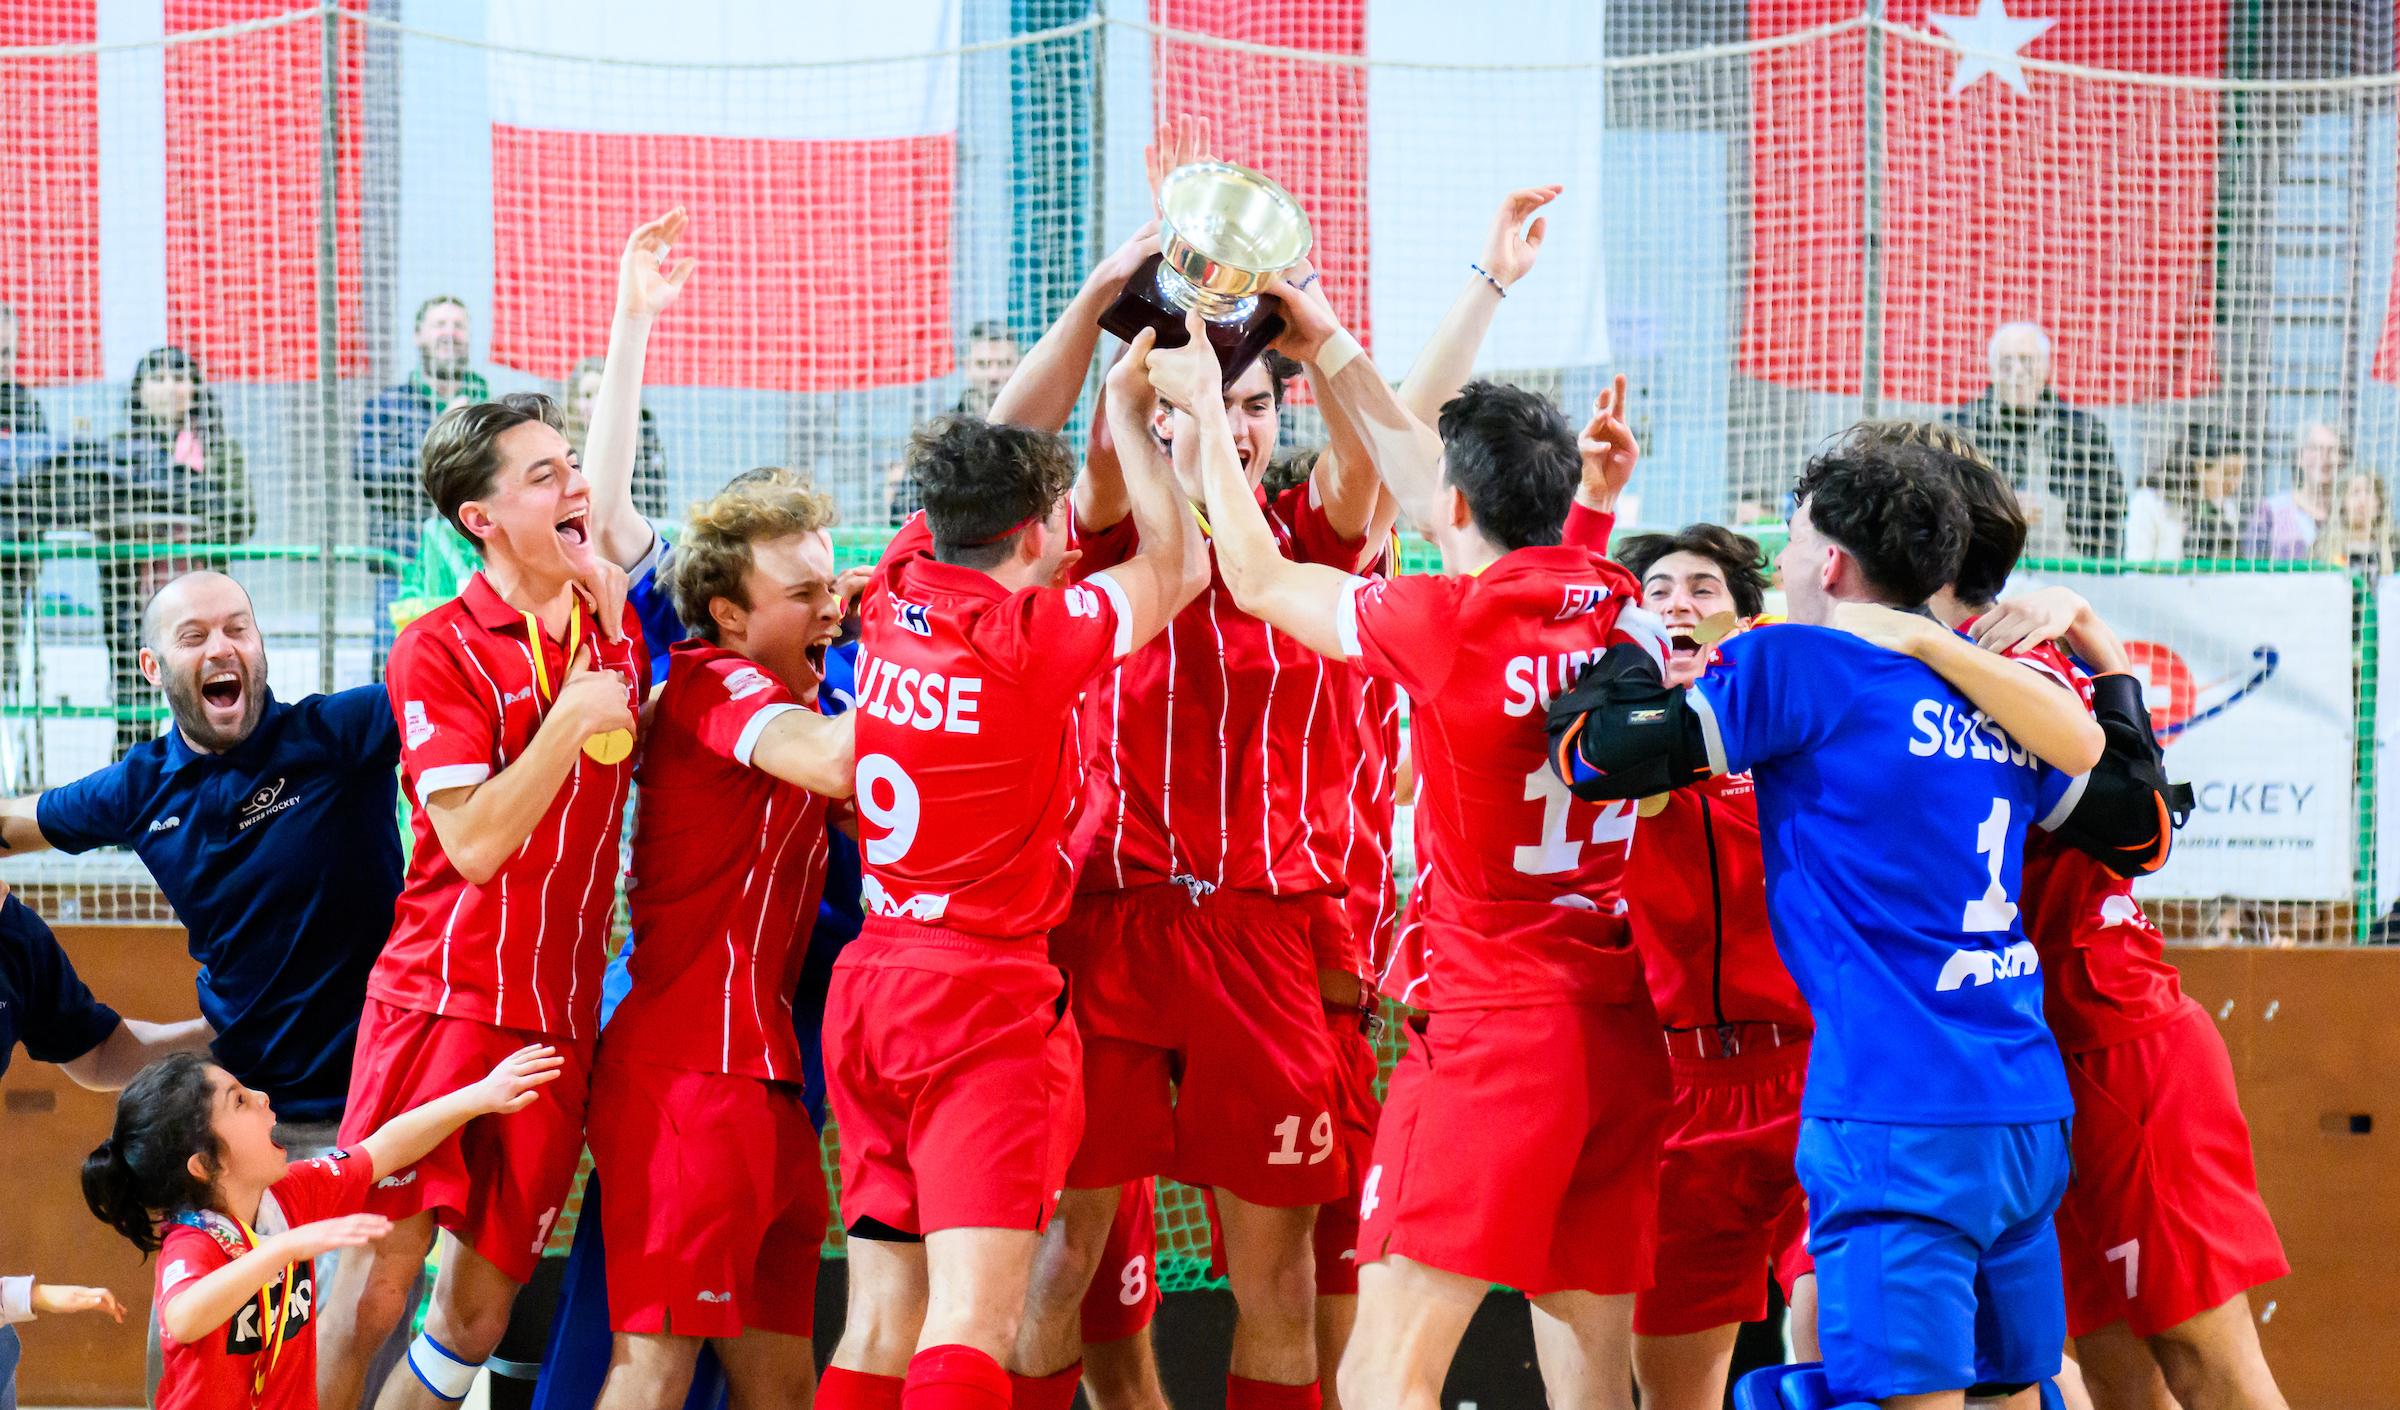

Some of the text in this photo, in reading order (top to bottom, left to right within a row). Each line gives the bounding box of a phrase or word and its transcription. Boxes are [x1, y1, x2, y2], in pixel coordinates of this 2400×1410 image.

[854, 643, 982, 734] UISSE
[1908, 698, 2038, 771] SUIS
[238, 794, 301, 830] SWISS HOCKEY
[855, 753, 920, 866] 9
[1512, 758, 1639, 876] 14
[2199, 780, 2315, 814] CKEY
[1962, 797, 2019, 933] 1
[1267, 1110, 1334, 1165] 19
[1119, 1254, 1148, 1306] 8
[2105, 1238, 2140, 1300] 7
